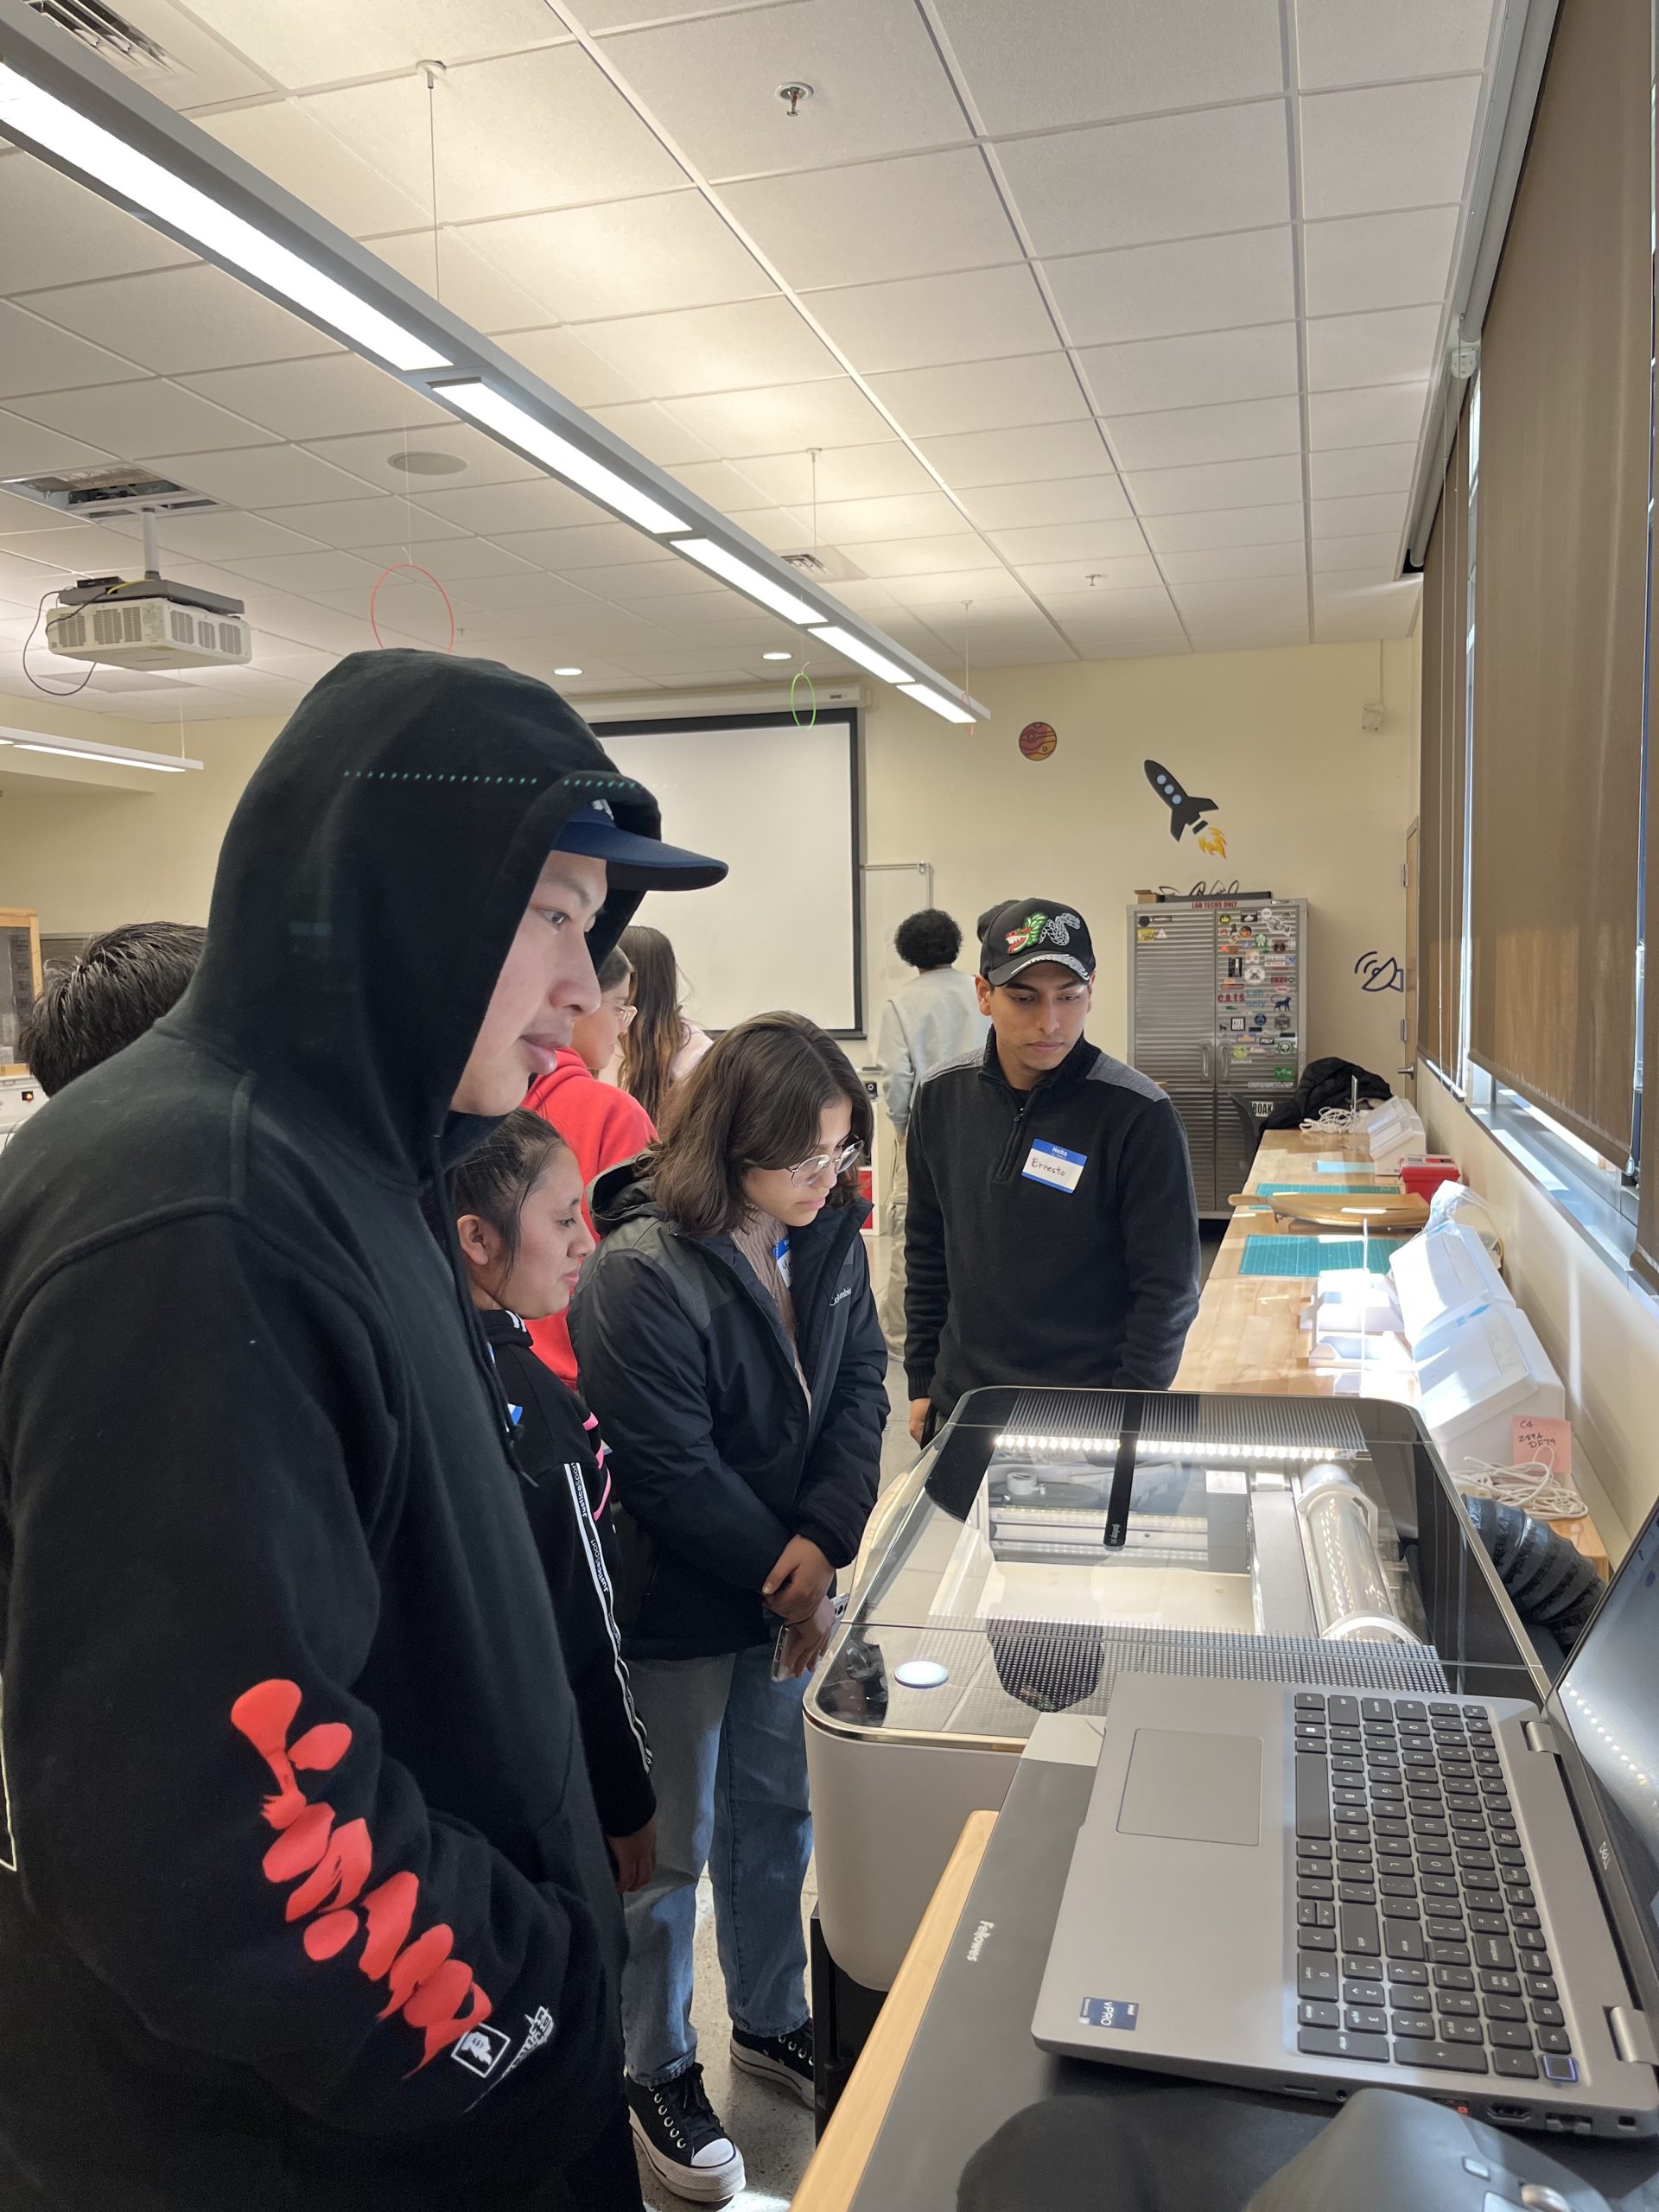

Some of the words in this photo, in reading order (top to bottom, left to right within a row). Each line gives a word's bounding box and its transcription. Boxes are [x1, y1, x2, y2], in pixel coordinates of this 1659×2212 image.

[1052, 1147, 1068, 1157] Hello
[1031, 1158, 1065, 1176] Ernesto
[967, 1920, 995, 1962] Fellowes
[1100, 2001, 1115, 2025] vPRO
